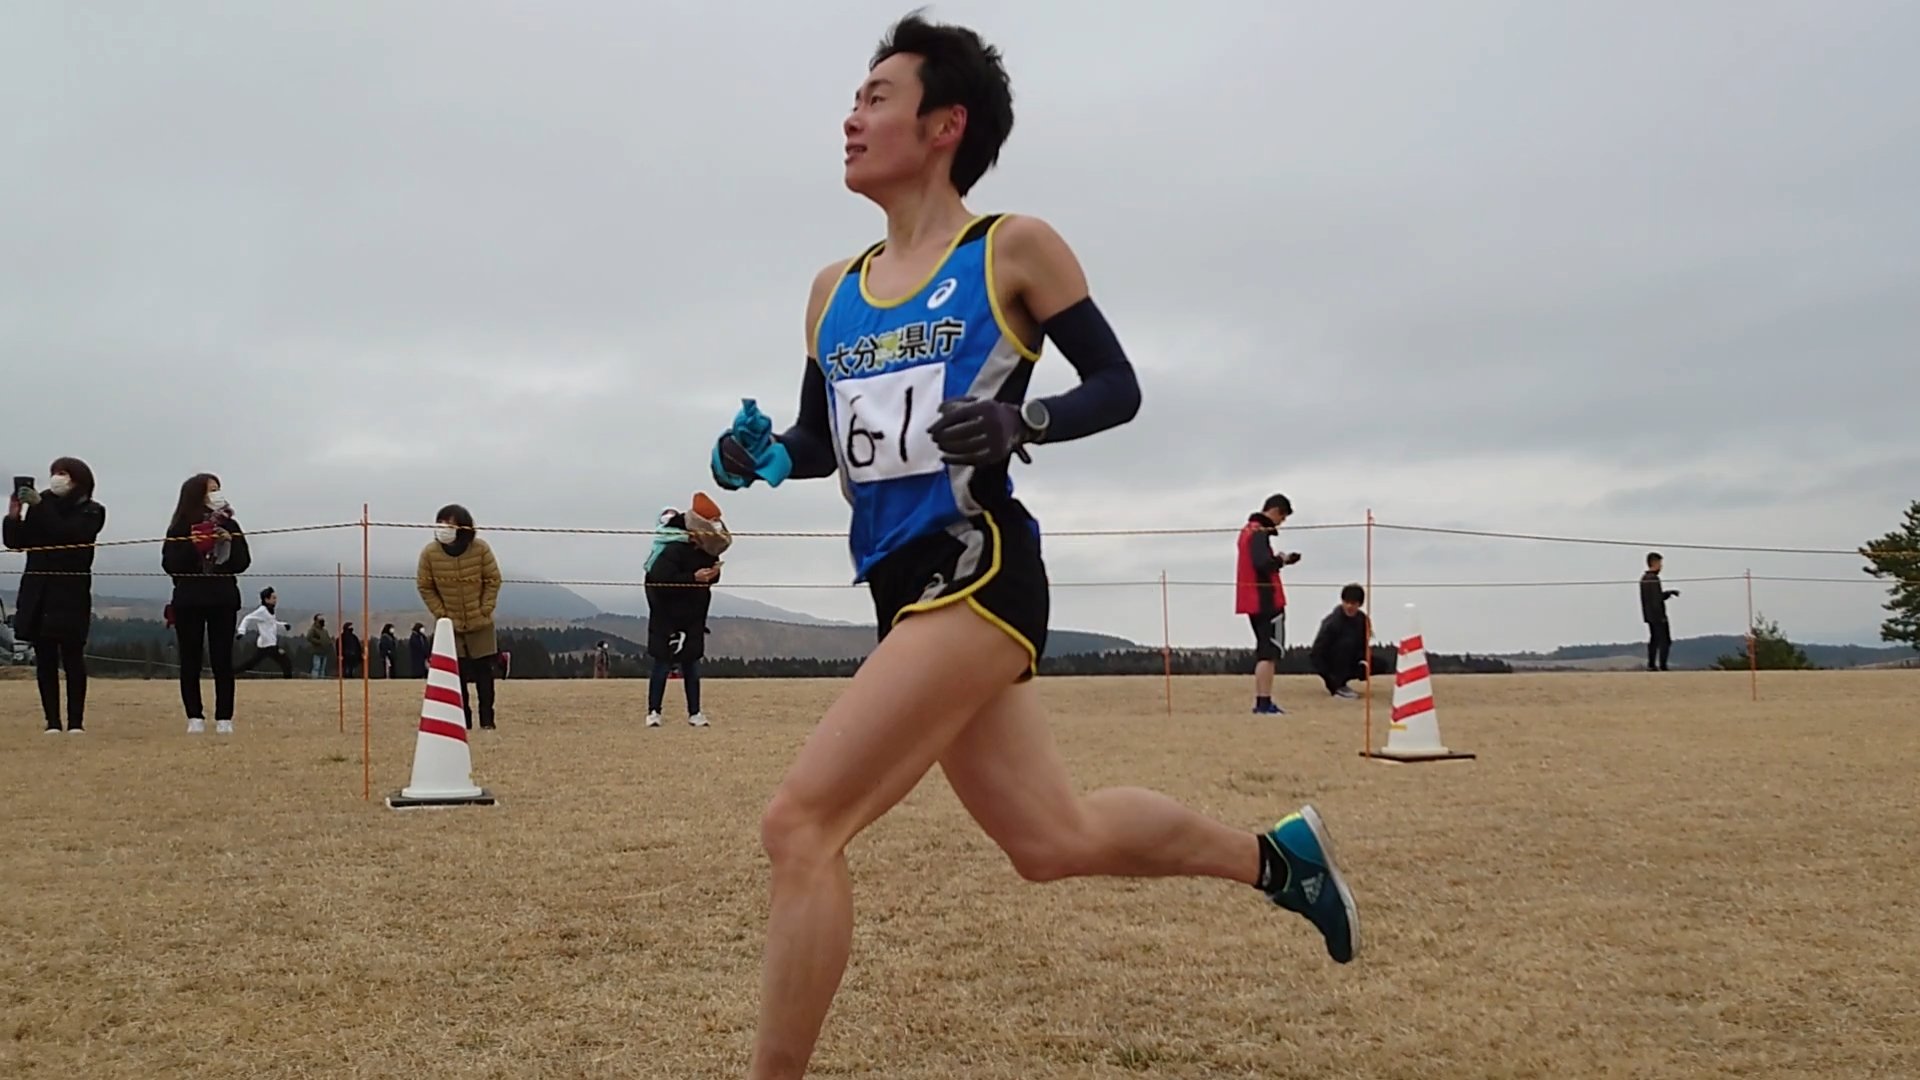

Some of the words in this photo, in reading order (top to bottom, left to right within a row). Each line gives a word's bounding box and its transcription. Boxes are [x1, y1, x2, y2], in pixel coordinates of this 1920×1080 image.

[827, 317, 965, 379] 大分県庁
[847, 386, 914, 468] 6-1
